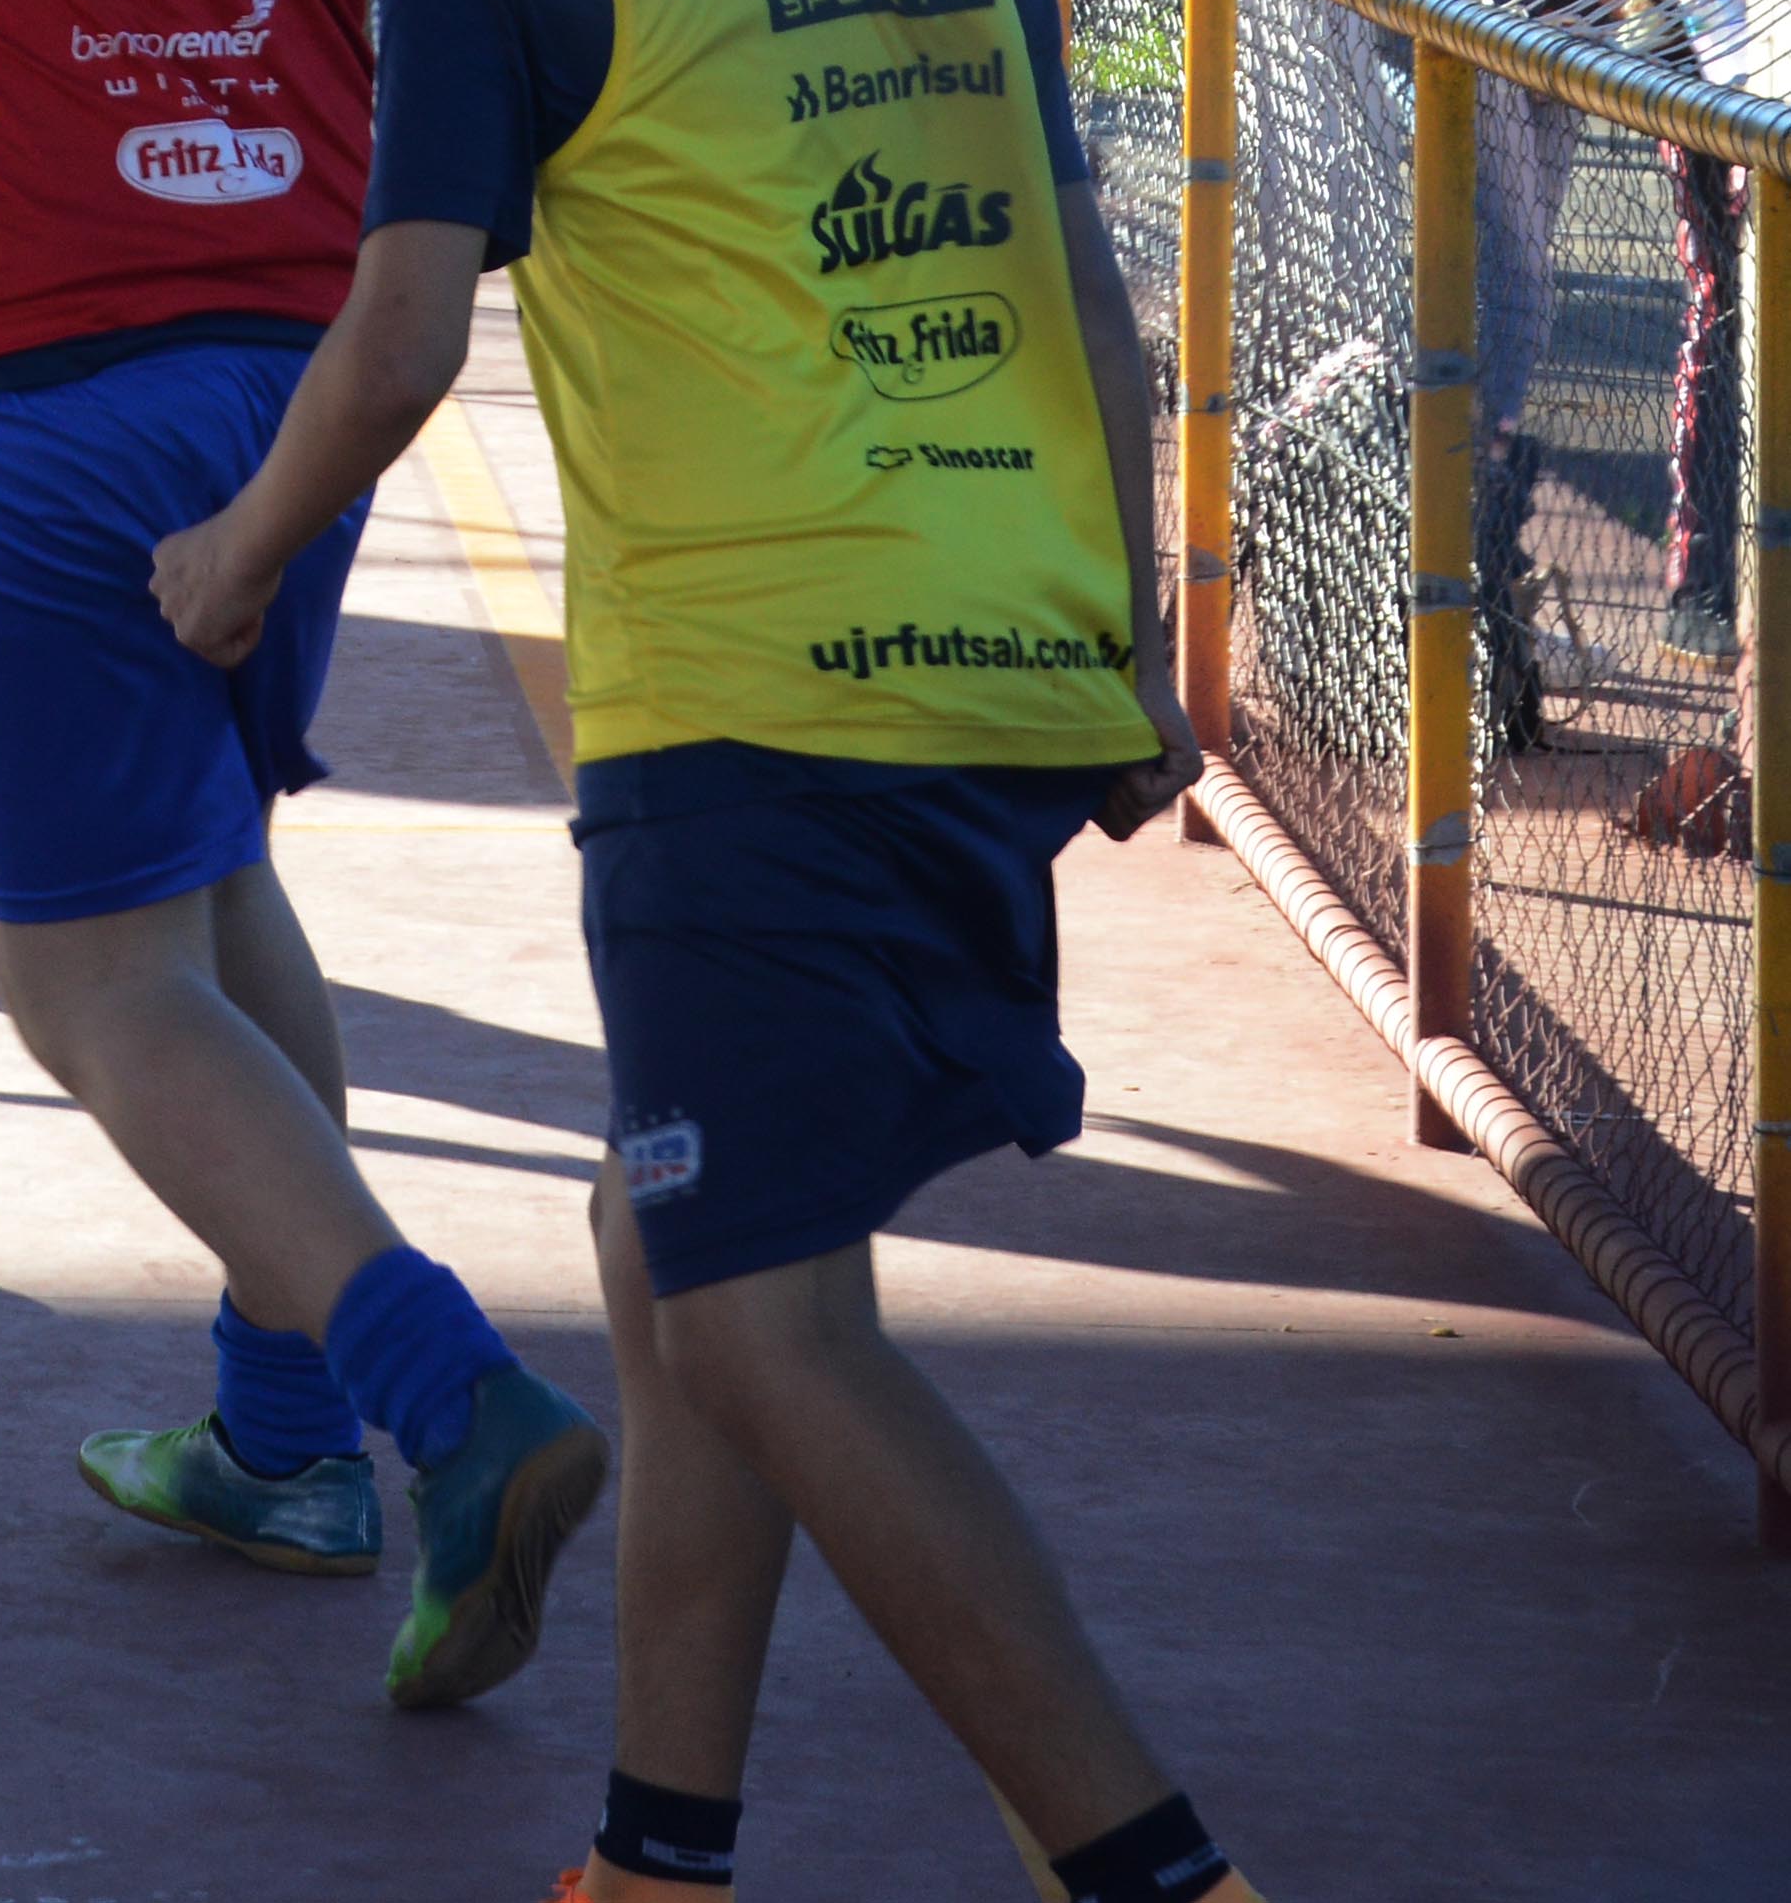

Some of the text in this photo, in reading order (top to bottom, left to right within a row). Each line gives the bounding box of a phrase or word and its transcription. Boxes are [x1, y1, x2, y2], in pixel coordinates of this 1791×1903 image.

[824, 49, 1005, 114] Banrisul
[136, 137, 222, 180] Fritz
[911, 307, 1002, 365] Frida
[918, 442, 1035, 471] Sinoscar
